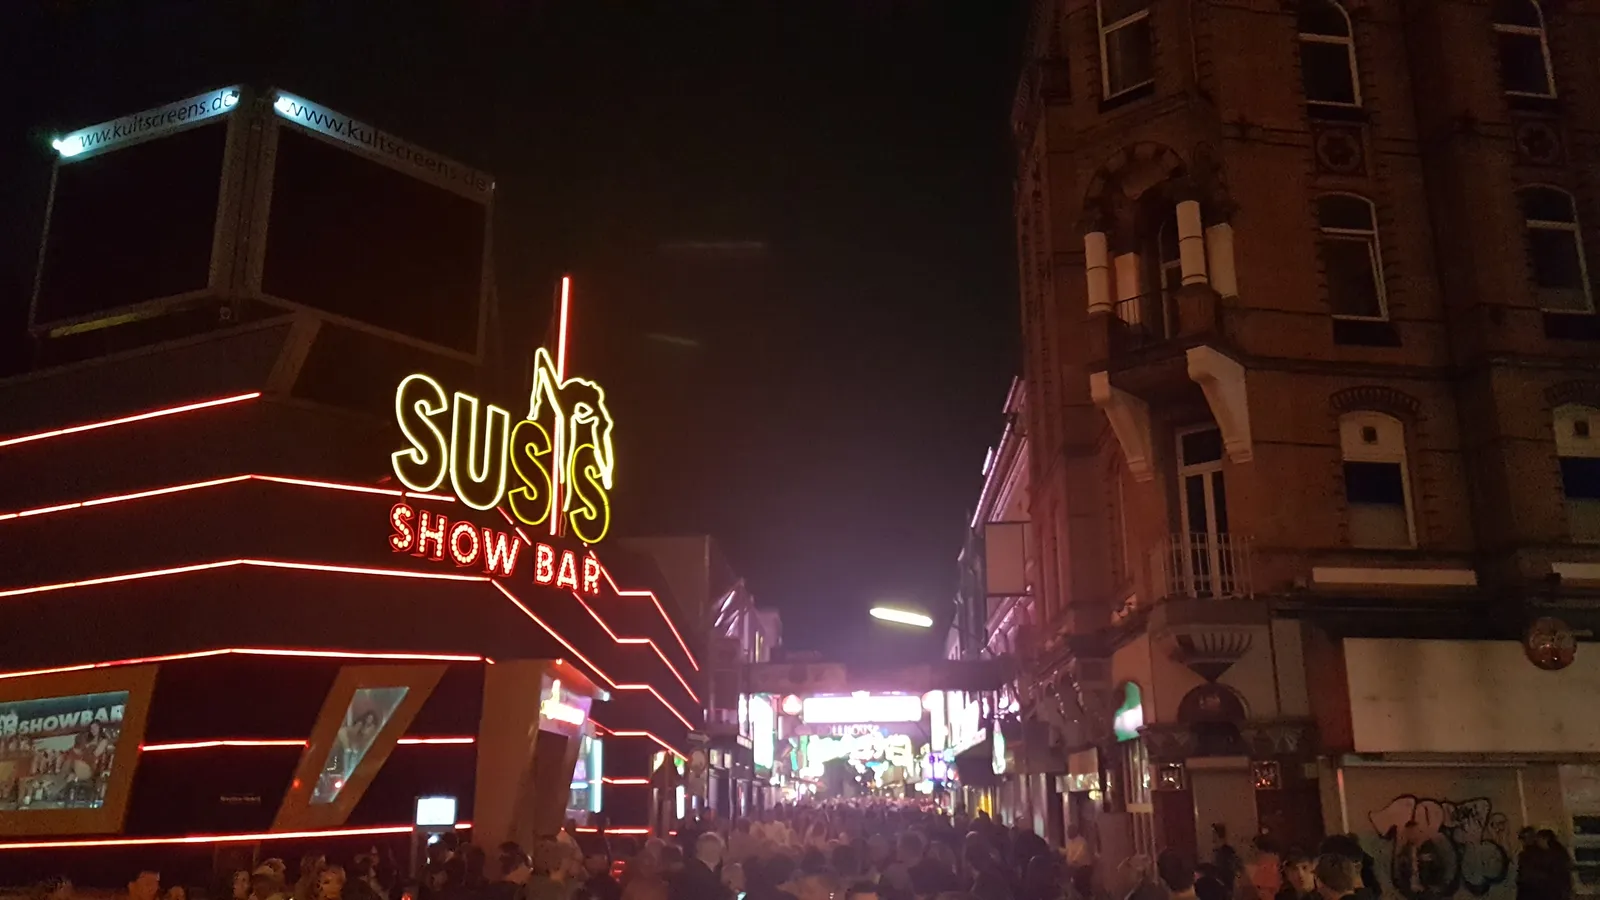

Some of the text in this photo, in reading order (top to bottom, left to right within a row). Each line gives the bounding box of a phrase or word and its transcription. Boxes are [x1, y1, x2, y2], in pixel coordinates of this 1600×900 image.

[76, 91, 237, 149] ww.kultscreens.de
[283, 98, 488, 192] www.kultscreensde
[389, 502, 602, 595] SHOW BAR
